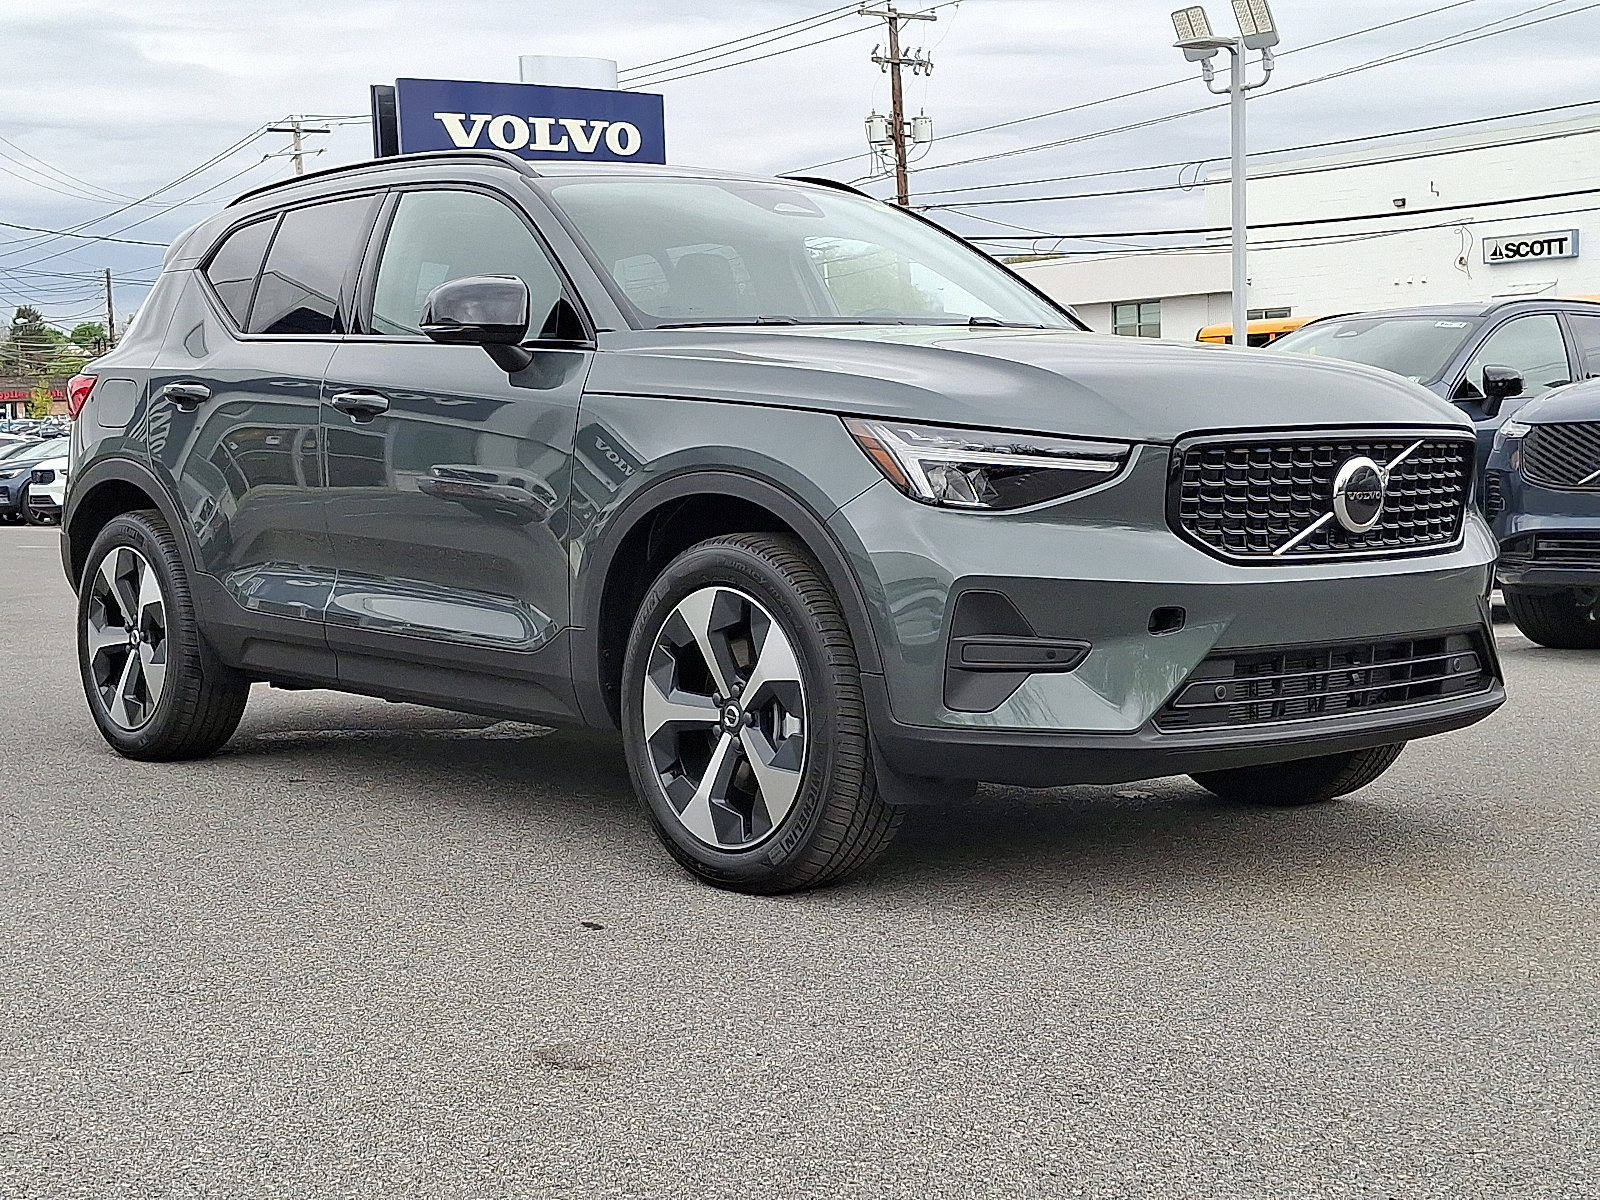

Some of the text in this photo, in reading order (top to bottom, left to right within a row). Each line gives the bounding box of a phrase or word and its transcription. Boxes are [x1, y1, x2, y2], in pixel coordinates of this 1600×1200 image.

[433, 112, 642, 156] VOLVO
[1504, 237, 1568, 259] SCOTT
[1346, 490, 1382, 501] VOLVO
